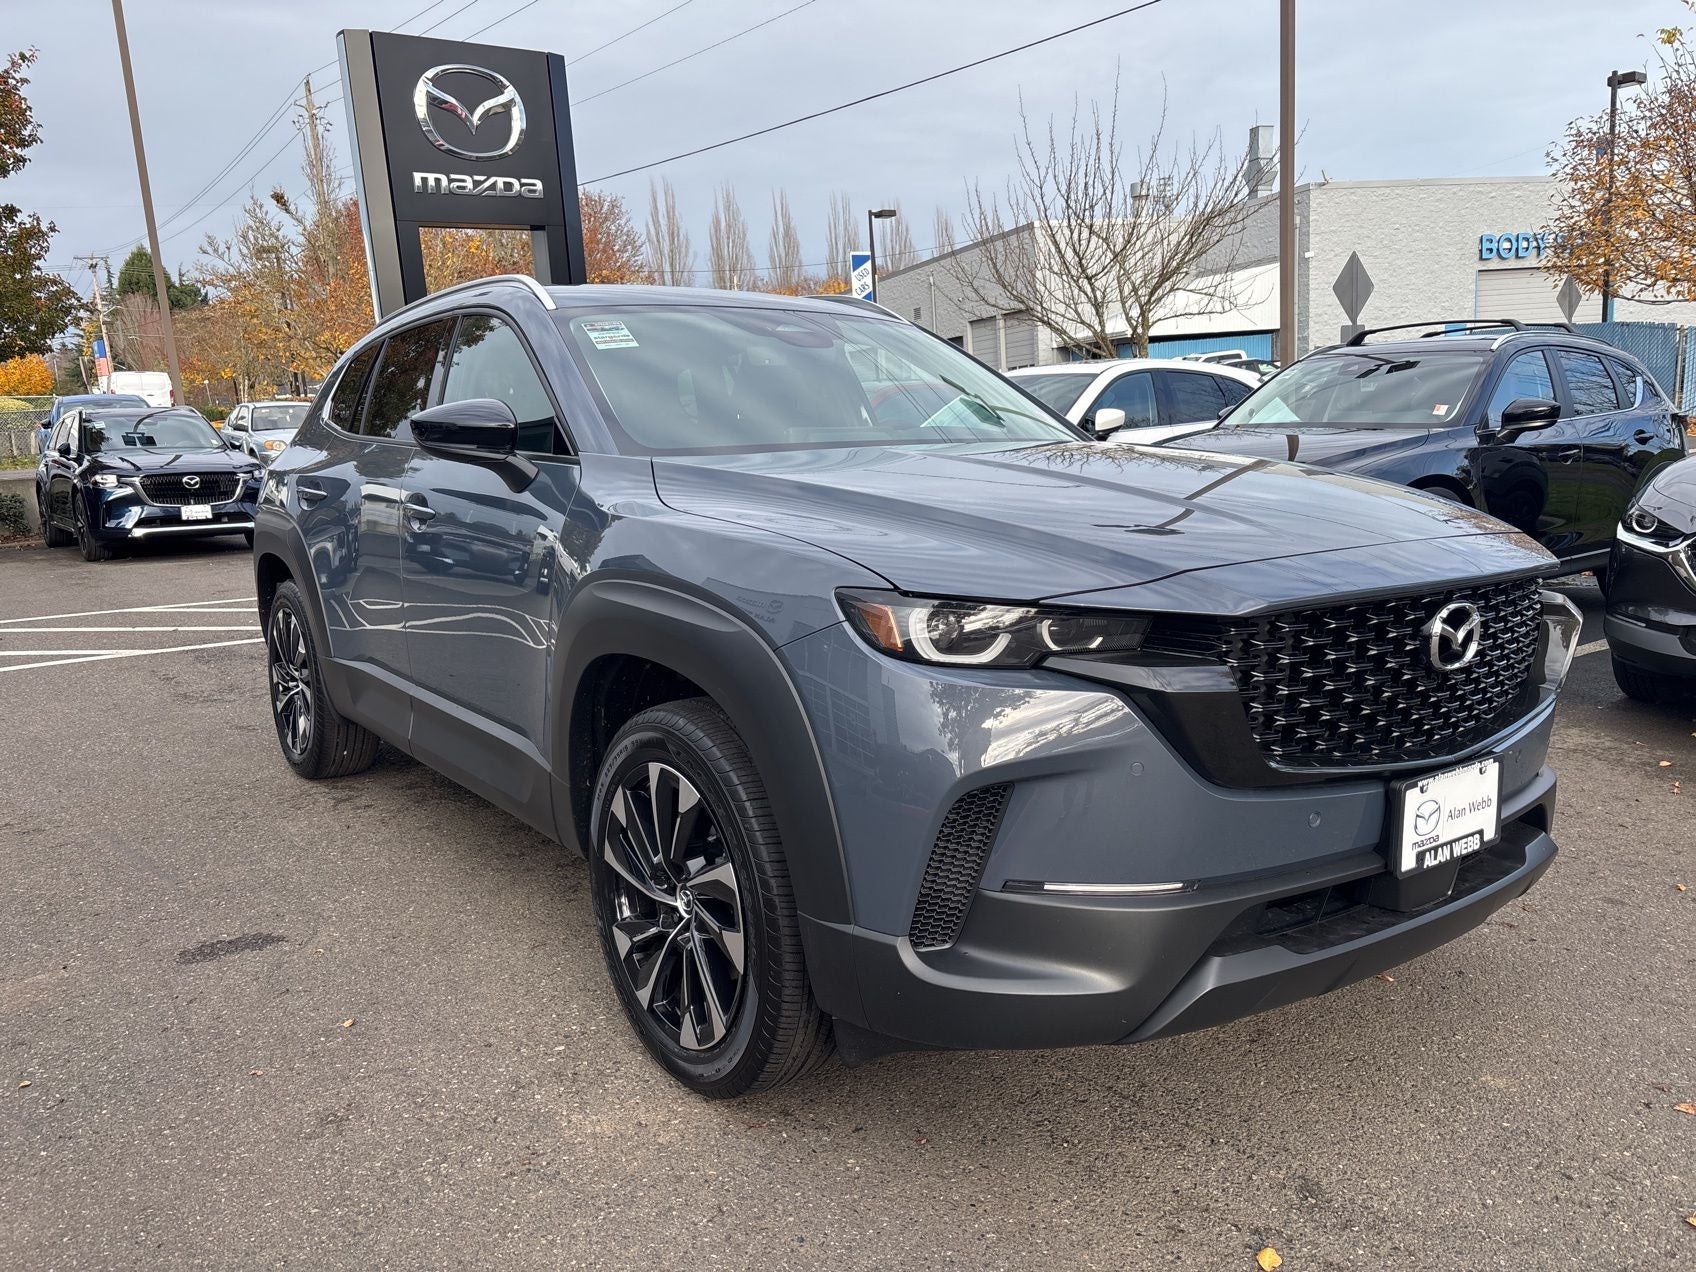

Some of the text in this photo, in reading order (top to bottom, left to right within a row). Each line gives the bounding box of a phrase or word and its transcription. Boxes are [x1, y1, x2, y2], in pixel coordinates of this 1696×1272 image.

[1479, 232, 1548, 260] BODY
[854, 267, 870, 282] USED
[854, 281, 870, 296] CARS
[1446, 795, 1492, 822] Alan Webb
[1423, 834, 1480, 868] ALAN WEBB
